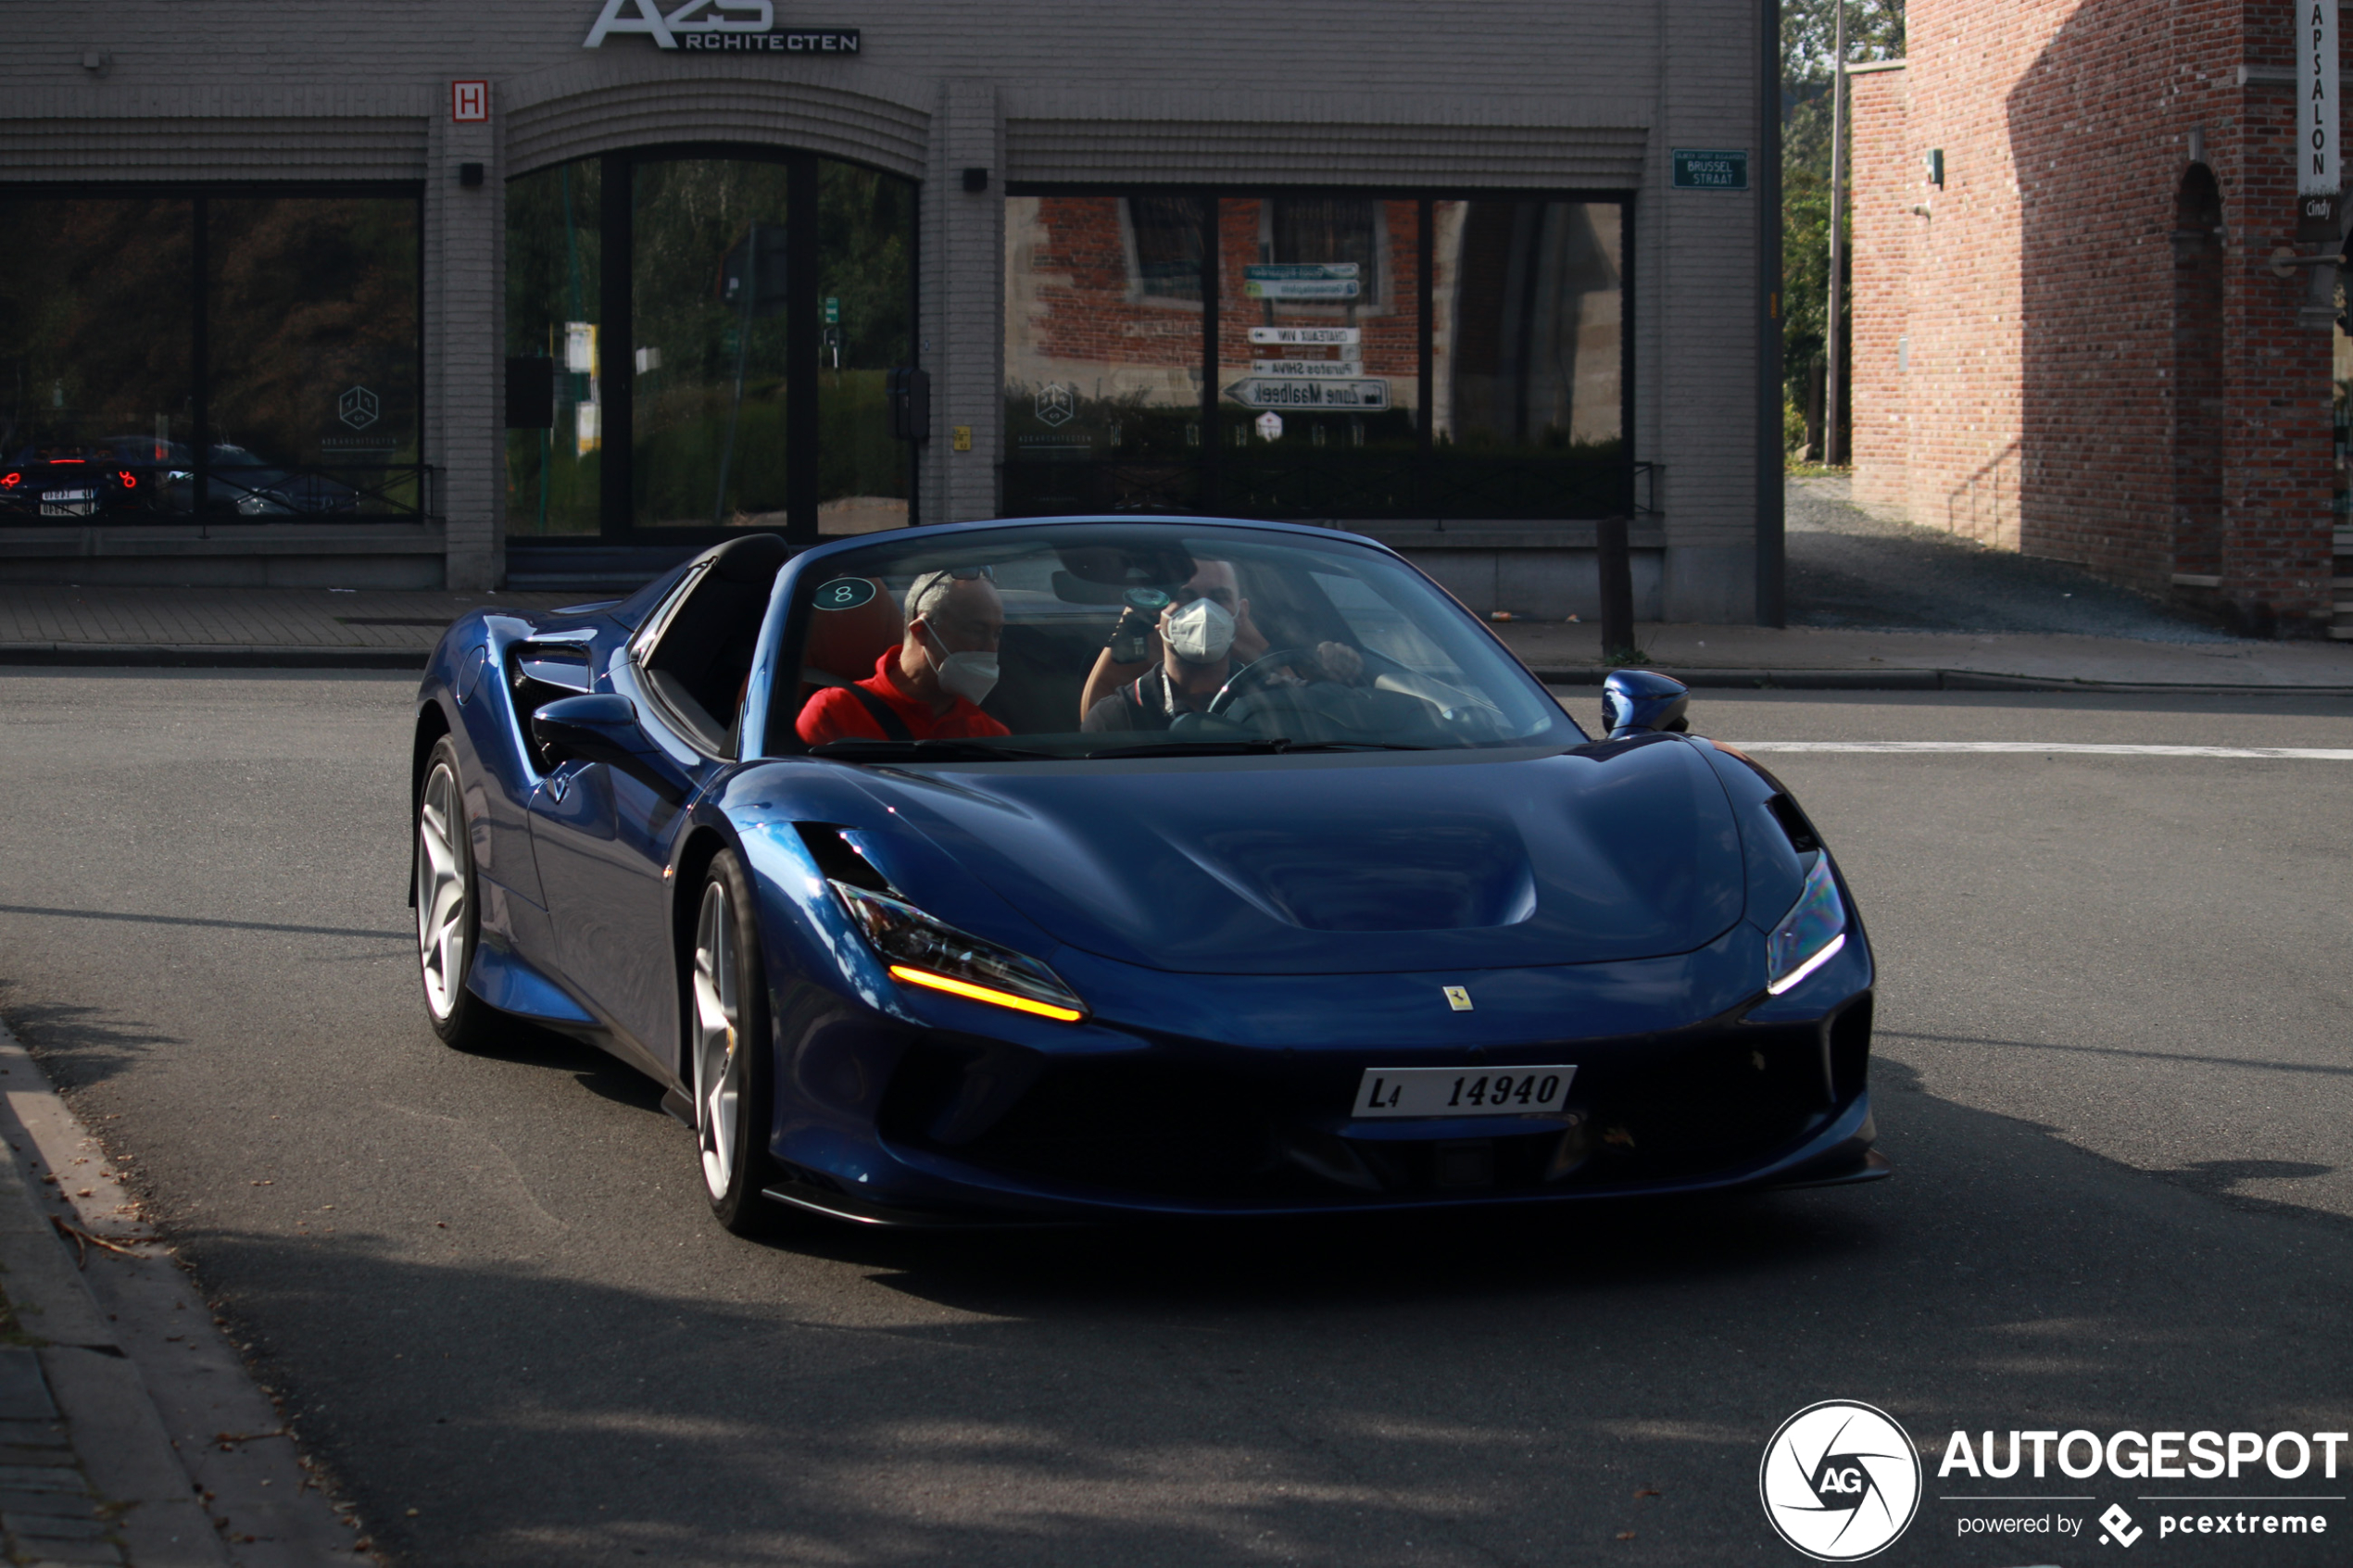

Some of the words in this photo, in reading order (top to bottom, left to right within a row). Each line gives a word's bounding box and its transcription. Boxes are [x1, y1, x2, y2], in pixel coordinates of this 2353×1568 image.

[686, 34, 858, 51] RCHITECTEN
[2310, 0, 2325, 175] APSALON
[460, 87, 479, 115] H
[1687, 160, 1733, 172] BRUSSEL
[1692, 173, 1733, 184] STRAAT
[2306, 199, 2332, 220] Cindy
[835, 585, 853, 603] 8
[1447, 1075, 1560, 1106] 14940
